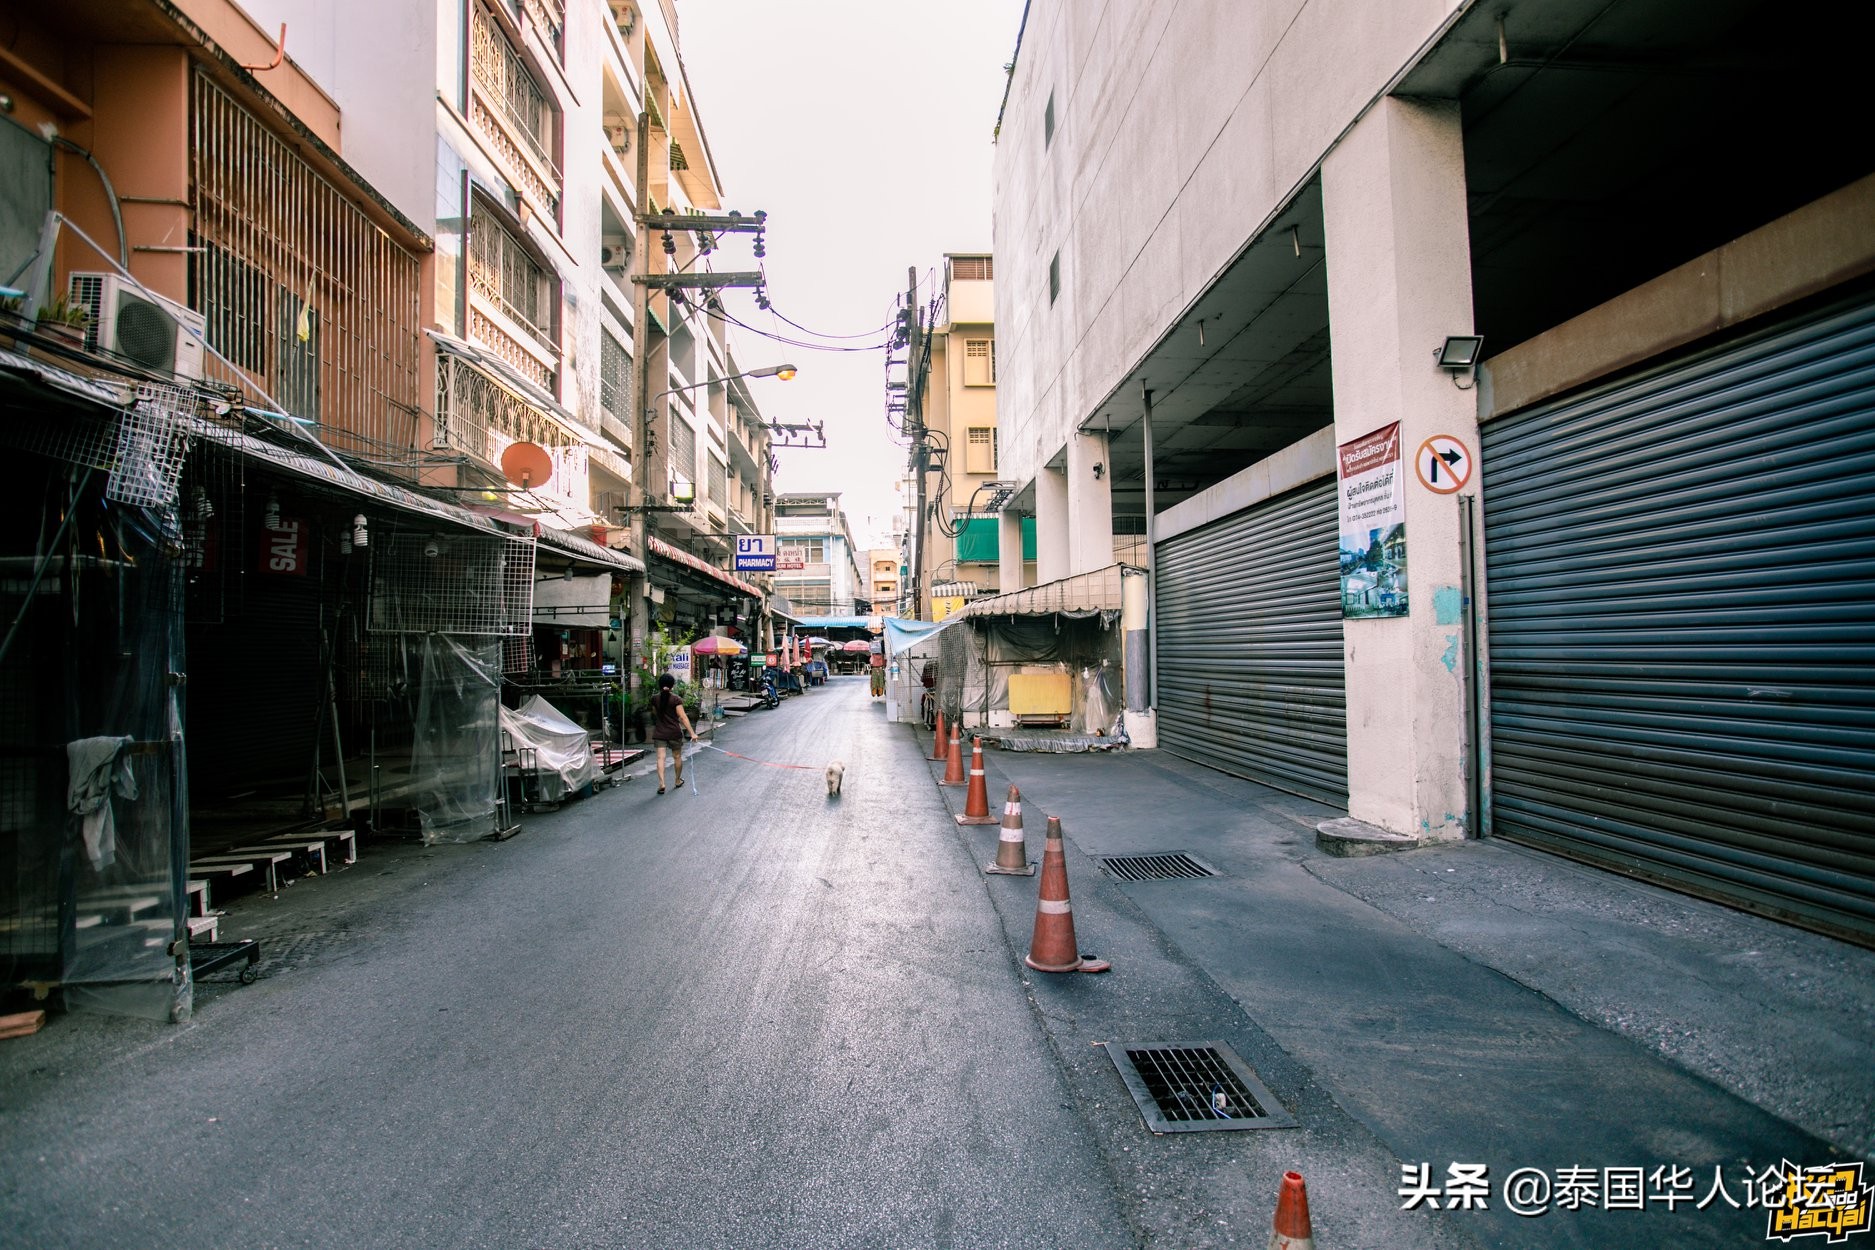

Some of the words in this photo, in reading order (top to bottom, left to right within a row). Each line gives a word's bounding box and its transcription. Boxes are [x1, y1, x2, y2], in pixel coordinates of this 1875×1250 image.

[269, 520, 299, 572] SALE
[739, 538, 763, 552] ยา
[738, 558, 774, 567] PHARMACY
